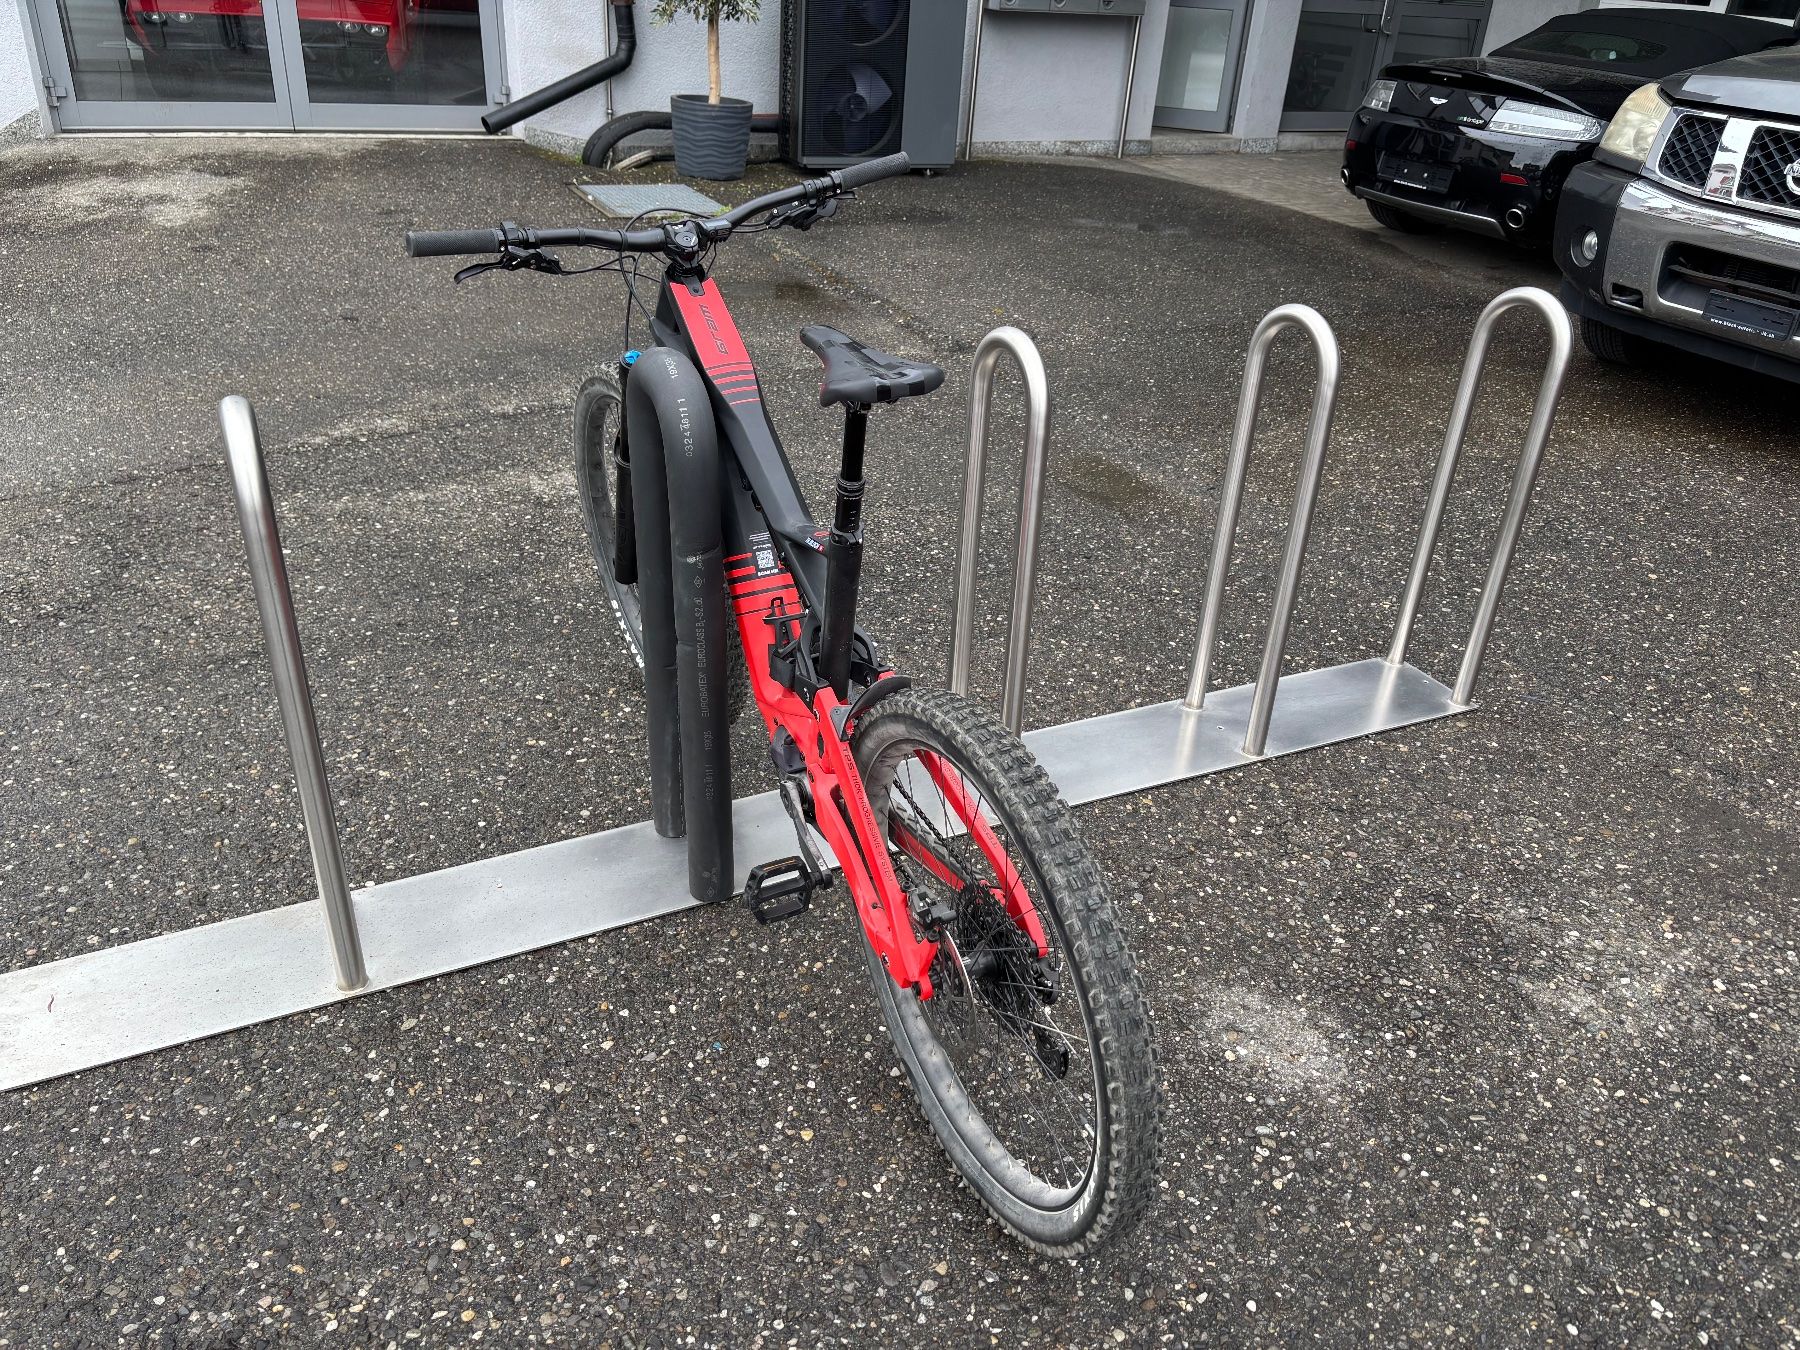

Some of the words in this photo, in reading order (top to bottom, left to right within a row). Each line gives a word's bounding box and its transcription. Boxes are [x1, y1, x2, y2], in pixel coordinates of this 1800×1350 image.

[610, 599, 645, 669] MAXXIS
[696, 629, 706, 668] EUROCLASS
[843, 746, 855, 771] TPS
[851, 773, 863, 795] THOK
[860, 795, 882, 849] PROGRESSIVE
